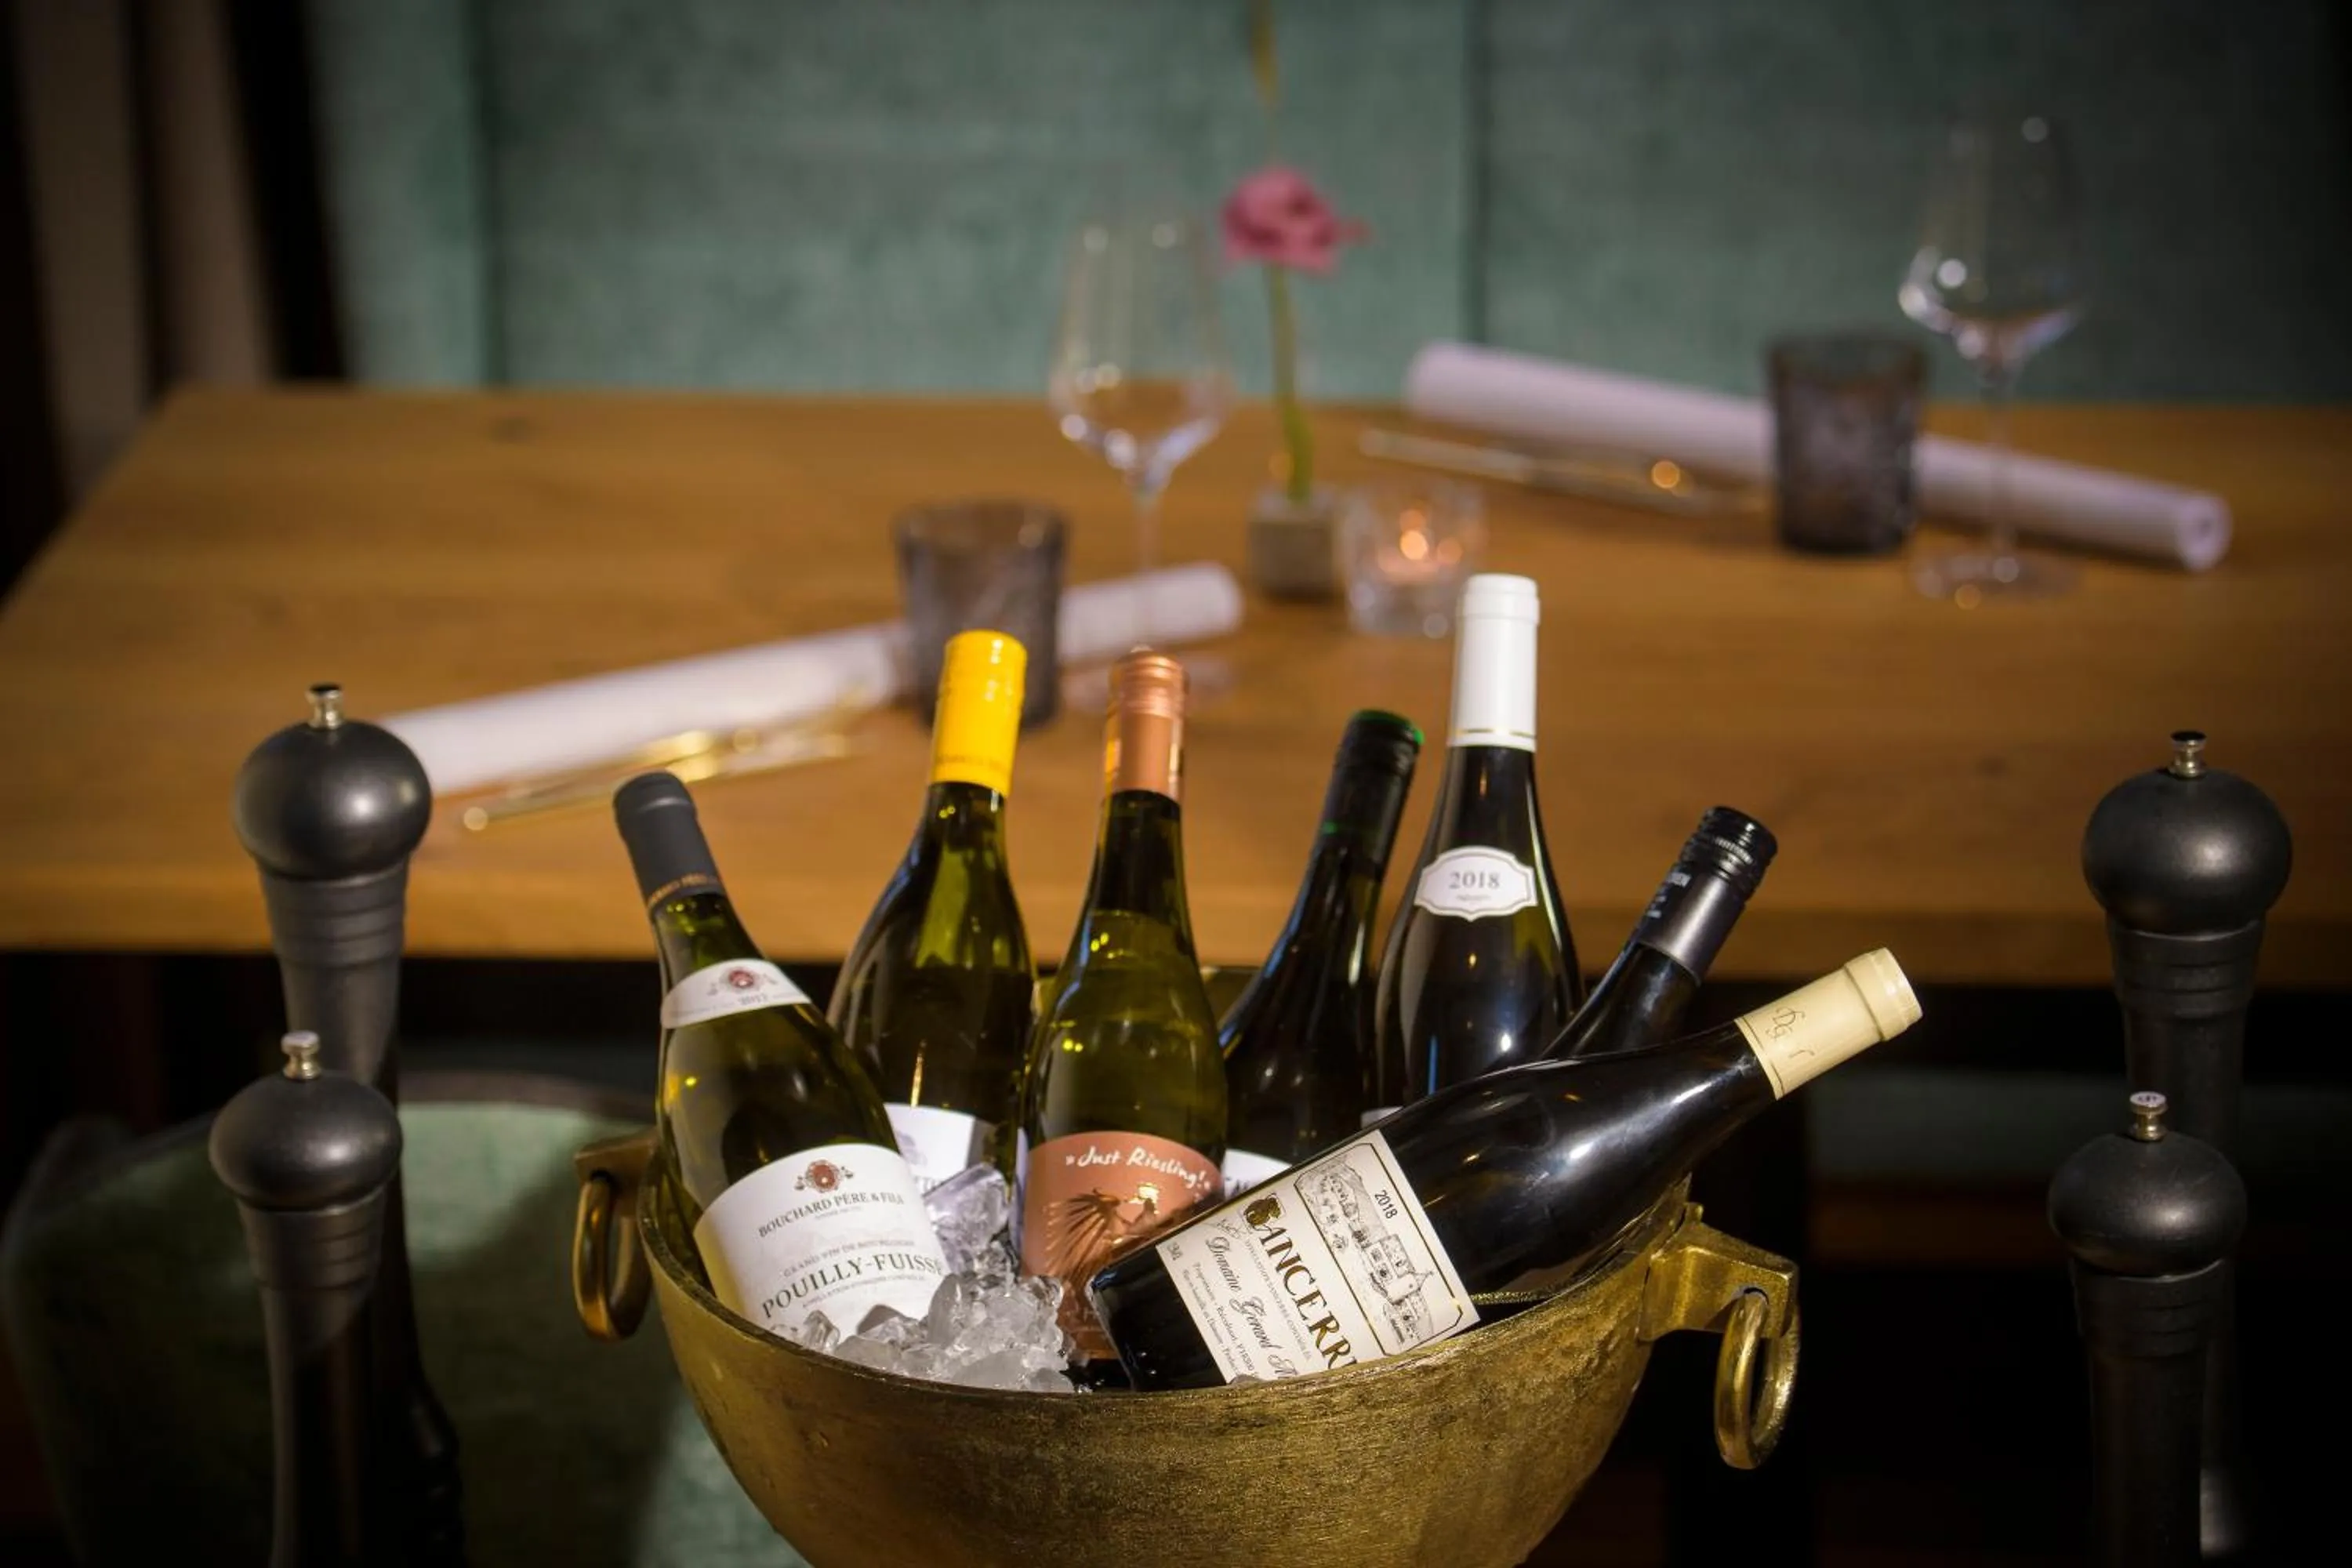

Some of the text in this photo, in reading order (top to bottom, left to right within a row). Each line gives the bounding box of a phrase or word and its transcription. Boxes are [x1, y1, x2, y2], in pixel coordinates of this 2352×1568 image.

[1449, 869, 1500, 890] 2018
[1077, 1145, 1121, 1167] Just
[1126, 1147, 1205, 1189] Riesling!
[758, 1198, 833, 1238] BOUCHARD
[1374, 1189, 1398, 1219] 2018
[1205, 1236, 1243, 1293] Domaine
